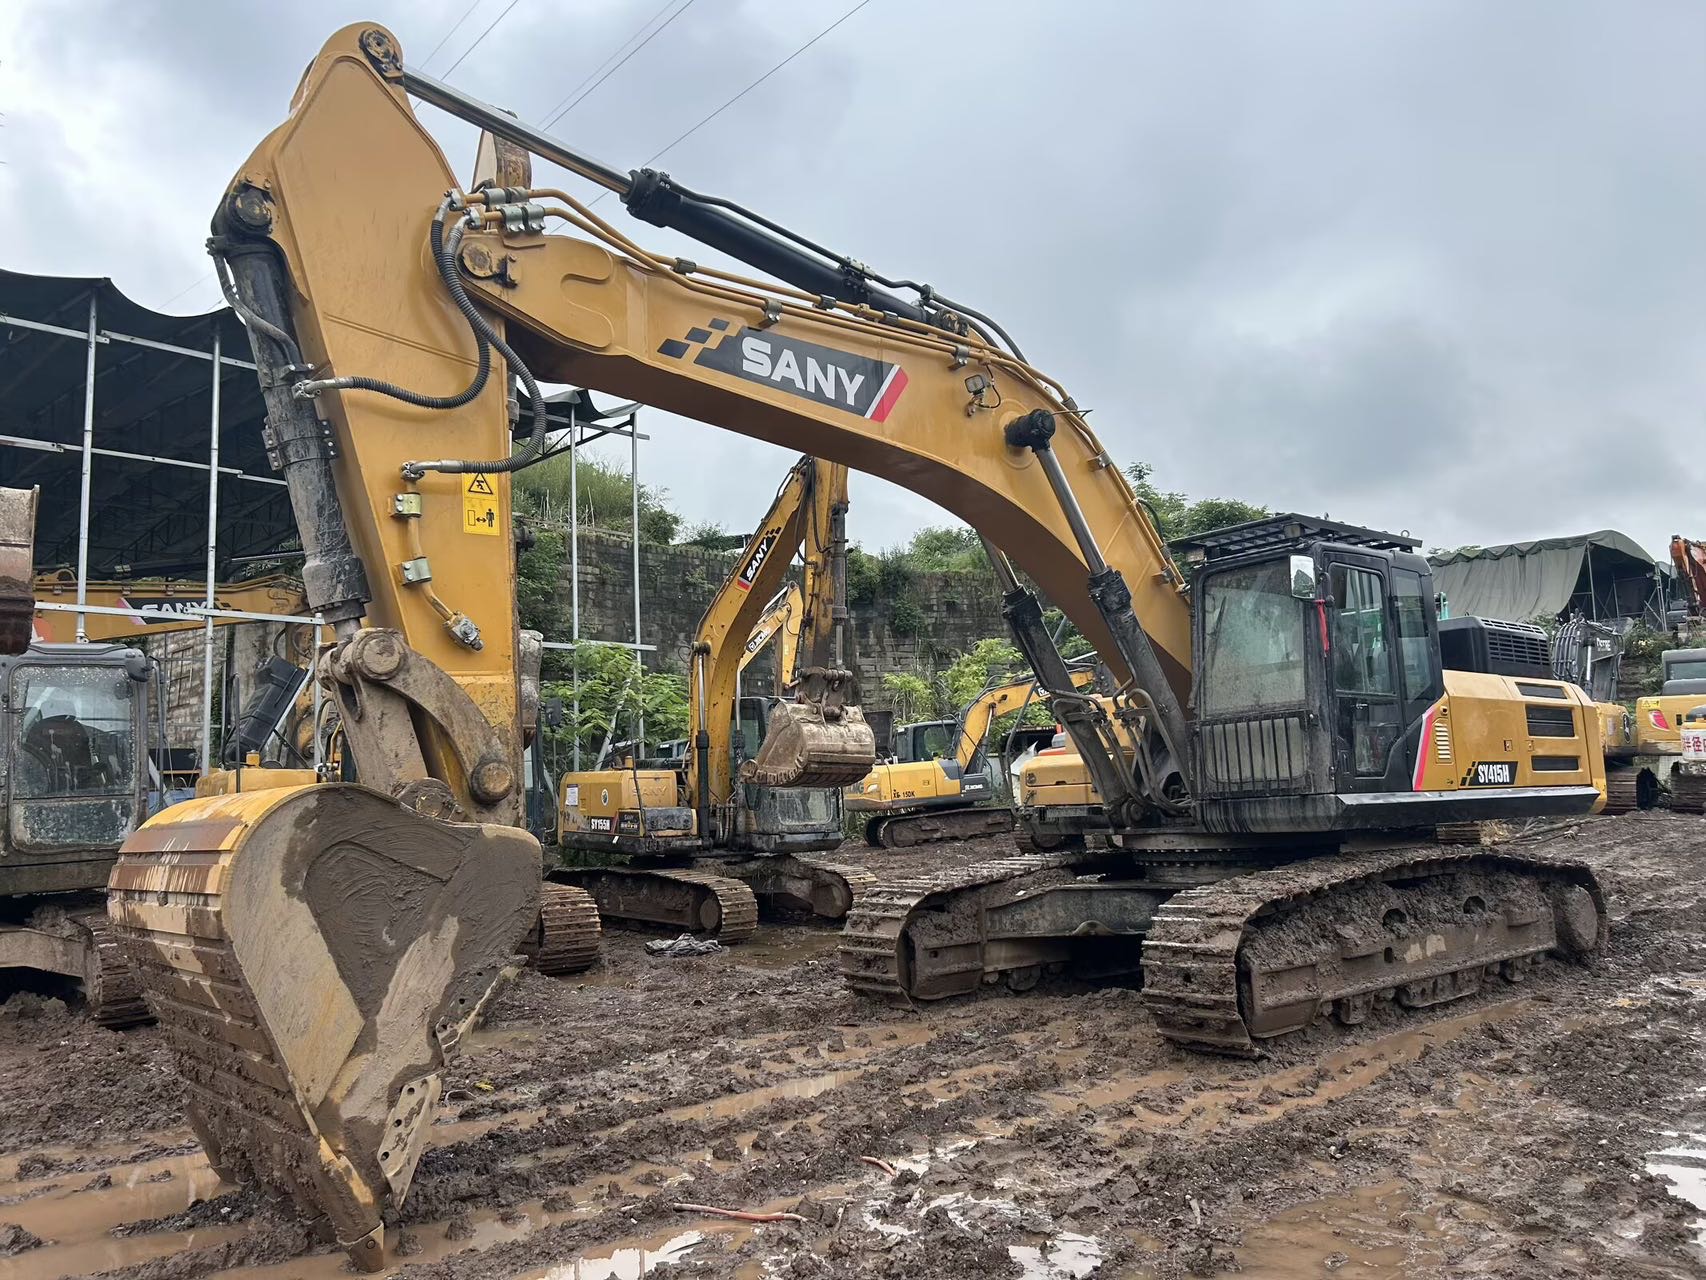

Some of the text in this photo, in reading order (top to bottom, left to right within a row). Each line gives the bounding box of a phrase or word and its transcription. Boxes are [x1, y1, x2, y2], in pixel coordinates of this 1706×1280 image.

[742, 336, 865, 406] SANY
[746, 538, 768, 581] SANY
[1477, 764, 1510, 783] SY415H
